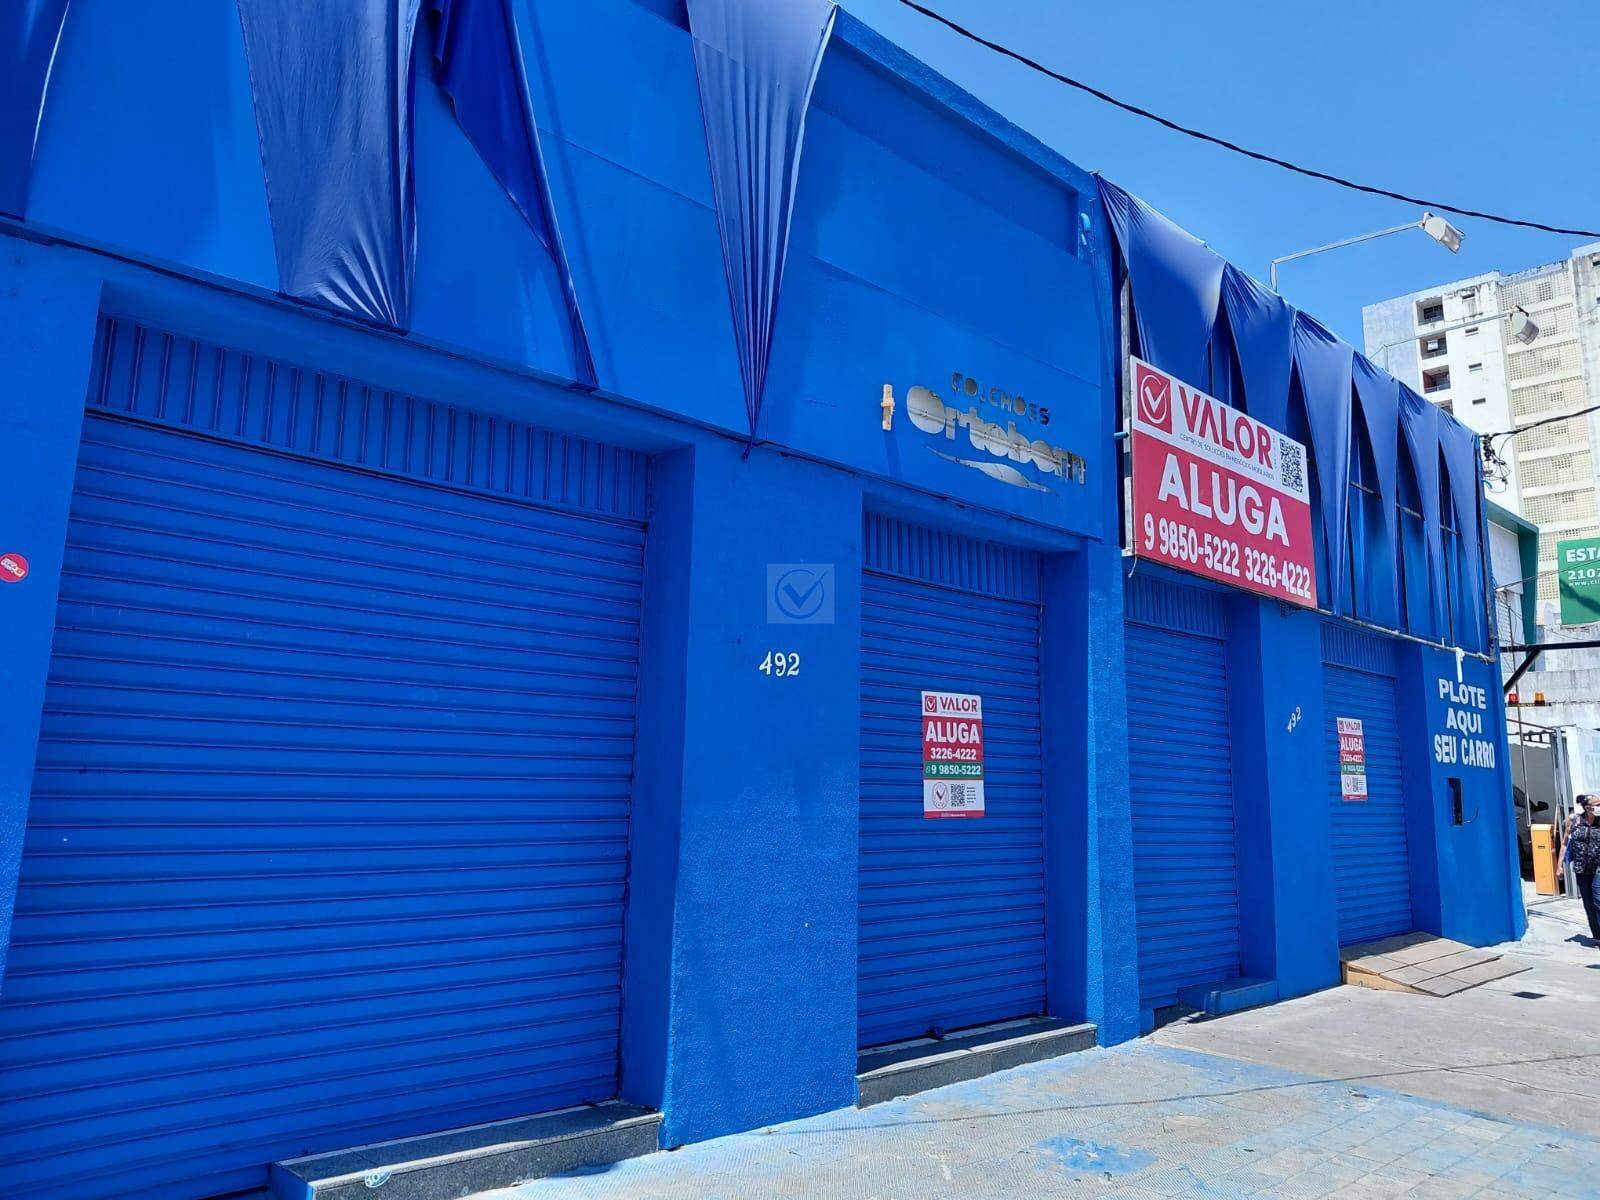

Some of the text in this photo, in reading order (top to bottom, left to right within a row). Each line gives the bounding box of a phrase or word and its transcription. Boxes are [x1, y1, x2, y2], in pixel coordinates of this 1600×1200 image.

[1177, 384, 1273, 469] VALOR
[1157, 452, 1290, 547] ALUGA
[1144, 512, 1312, 599] 9 9850-5222 3226-4222
[759, 650, 800, 677] 492
[939, 696, 978, 712] VALOR
[1438, 678, 1487, 709] PLOTE
[925, 721, 980, 744] ALUGA
[1287, 706, 1302, 733] 492
[1446, 707, 1483, 736] AQUI
[930, 747, 976, 760] 3226-4222
[1340, 736, 1364, 752] ALUGA
[1434, 734, 1496, 768] SEU CARRO
[931, 764, 981, 775] 9 9850-5222
